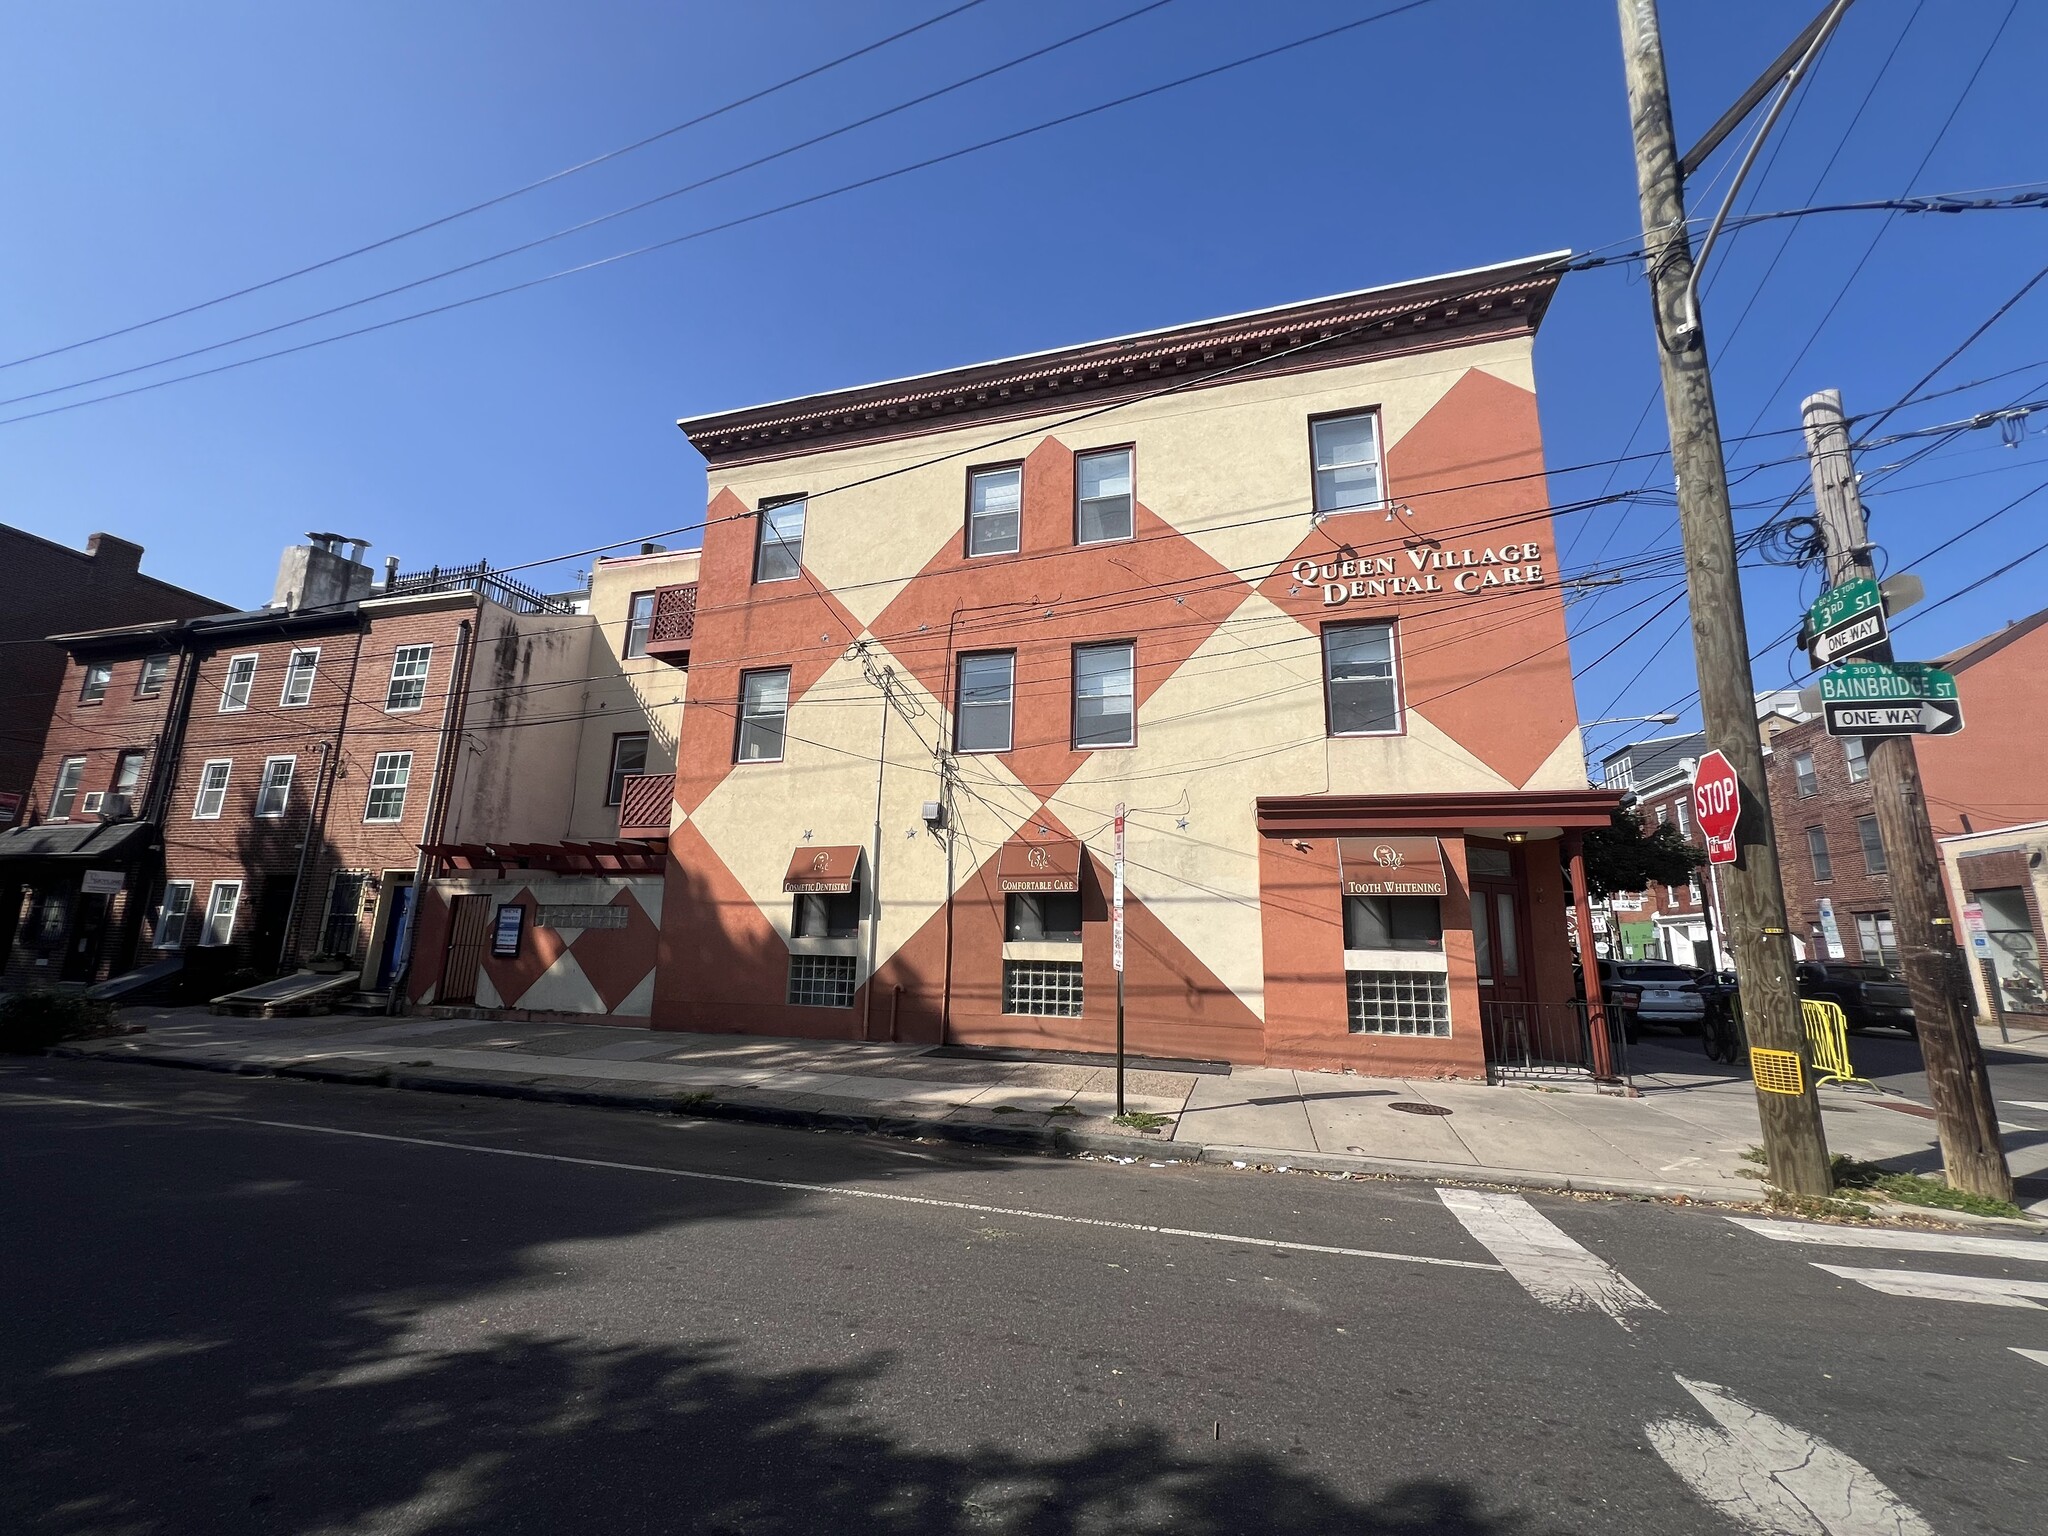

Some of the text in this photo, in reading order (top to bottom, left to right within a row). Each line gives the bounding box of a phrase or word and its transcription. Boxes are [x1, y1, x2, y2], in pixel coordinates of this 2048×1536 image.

[1291, 542, 1541, 587] QUEEN VILLAGE
[1322, 565, 1545, 607] DENTAL CARE
[1832, 589, 1840, 600] S
[1821, 591, 1872, 627] 3RD ST
[1828, 619, 1874, 651] ONE WAY
[1852, 666, 1877, 675] 300
[1879, 664, 1893, 675] W
[1823, 676, 1952, 699] BAINBRIDGE ST
[1841, 709, 1922, 726] ONE WAY
[1697, 777, 1734, 818] STOP
[785, 882, 849, 892] COSMETIC DENTISTRY
[1001, 879, 1074, 891] COMFORTABLE CARE
[1348, 880, 1441, 893] TOOTH WHITENING
